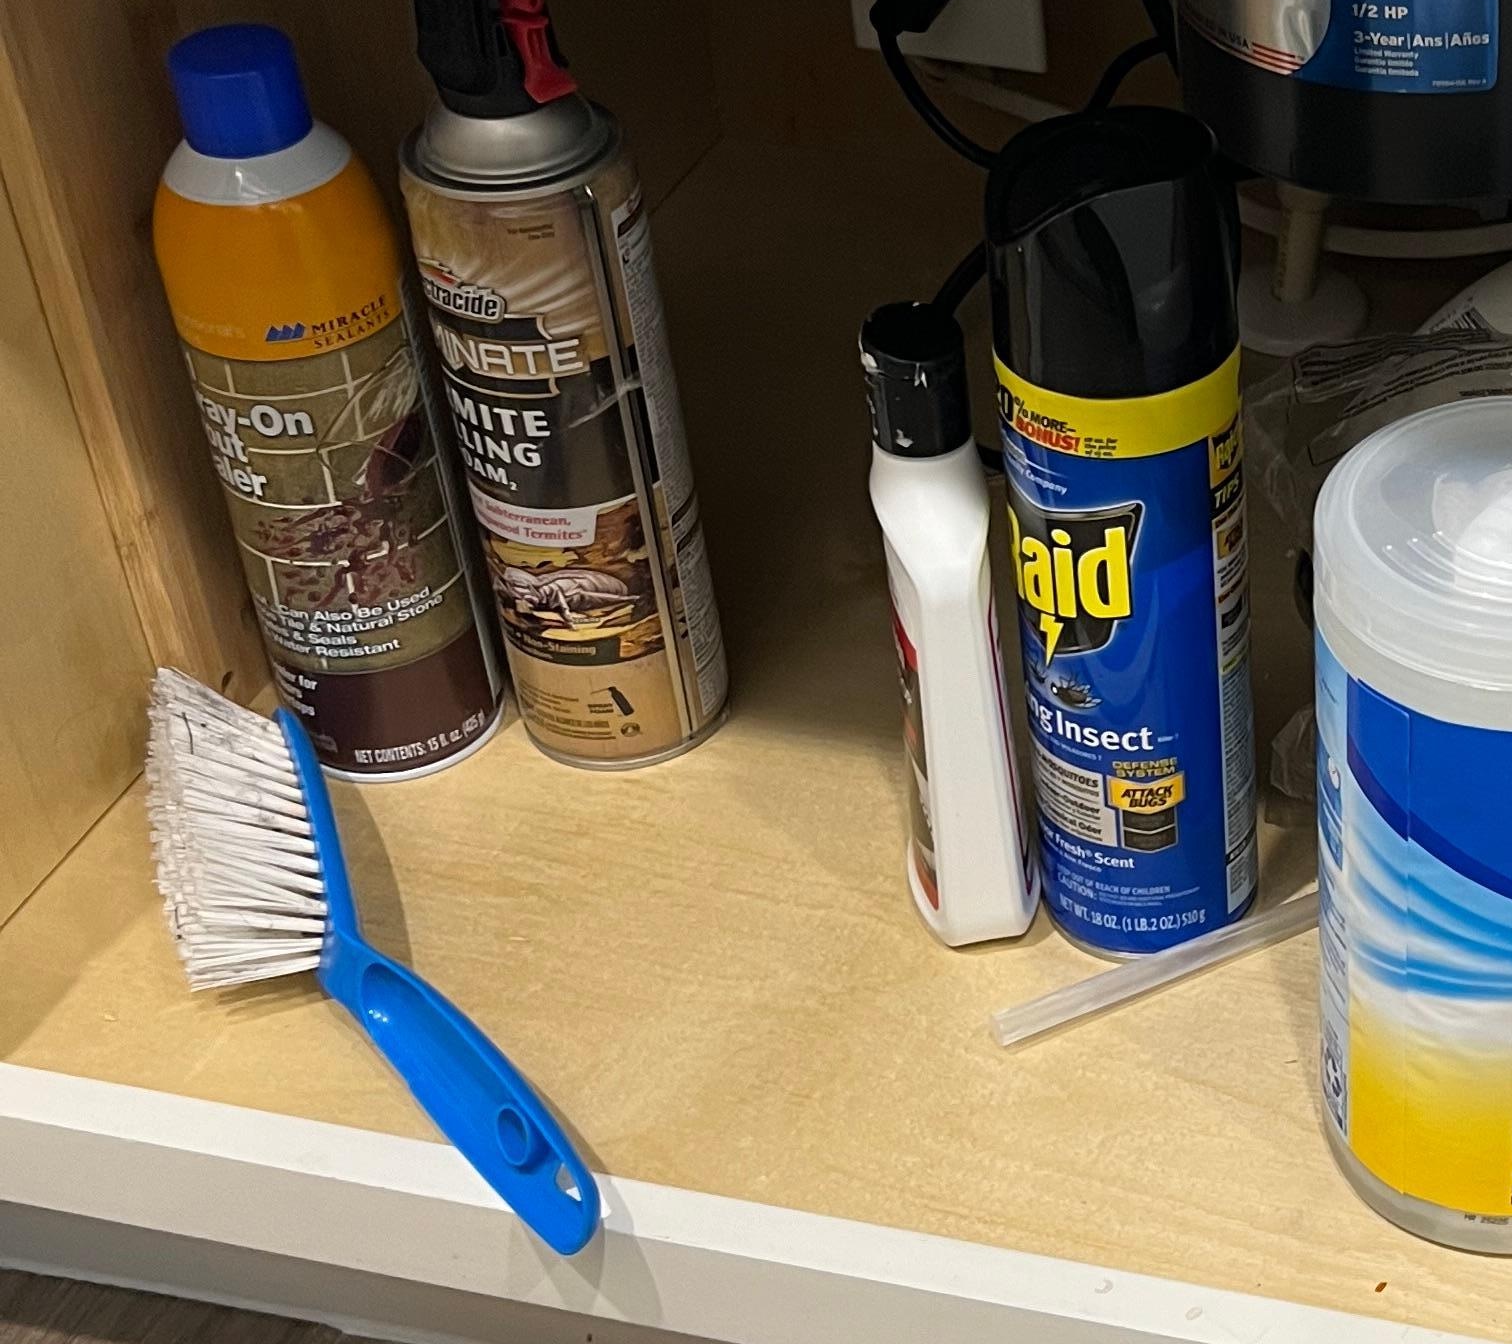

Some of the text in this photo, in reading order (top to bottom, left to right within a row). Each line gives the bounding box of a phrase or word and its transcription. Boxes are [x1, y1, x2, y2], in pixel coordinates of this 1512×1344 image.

[1352, 3, 1409, 20] 1/2 HP
[1353, 30, 1491, 48] 3-Year Ans Años
[312, 294, 387, 334] MIRACLE
[314, 309, 391, 349] SEALANTS
[1014, 416, 1081, 453] BONUS!
[309, 622, 322, 634] &
[327, 614, 394, 634] Natural
[397, 594, 445, 622] Stone
[313, 610, 354, 623] Also
[357, 605, 383, 620] Be
[386, 586, 430, 613] Used
[308, 631, 358, 646] Seals
[316, 639, 401, 658] Resistant
[1028, 694, 1155, 752] ng Insect
[355, 748, 375, 765] NET
[375, 742, 427, 763] CONTENTS:
[427, 736, 440, 753] 15
[1112, 756, 1178, 769] DEFENSE
[1116, 766, 1176, 779] SYSTEM
[1121, 784, 1174, 799] ATTACK
[1128, 797, 1168, 809] BUGS
[1094, 852, 1136, 869] Scent
[1057, 872, 1098, 900] CAUTION:
[1094, 881, 1119, 894] REACH
[1120, 885, 1131, 895] OF
[1131, 885, 1171, 896] CHILDREN
[1059, 893, 1075, 914] NET
[1091, 910, 1105, 926] 18
